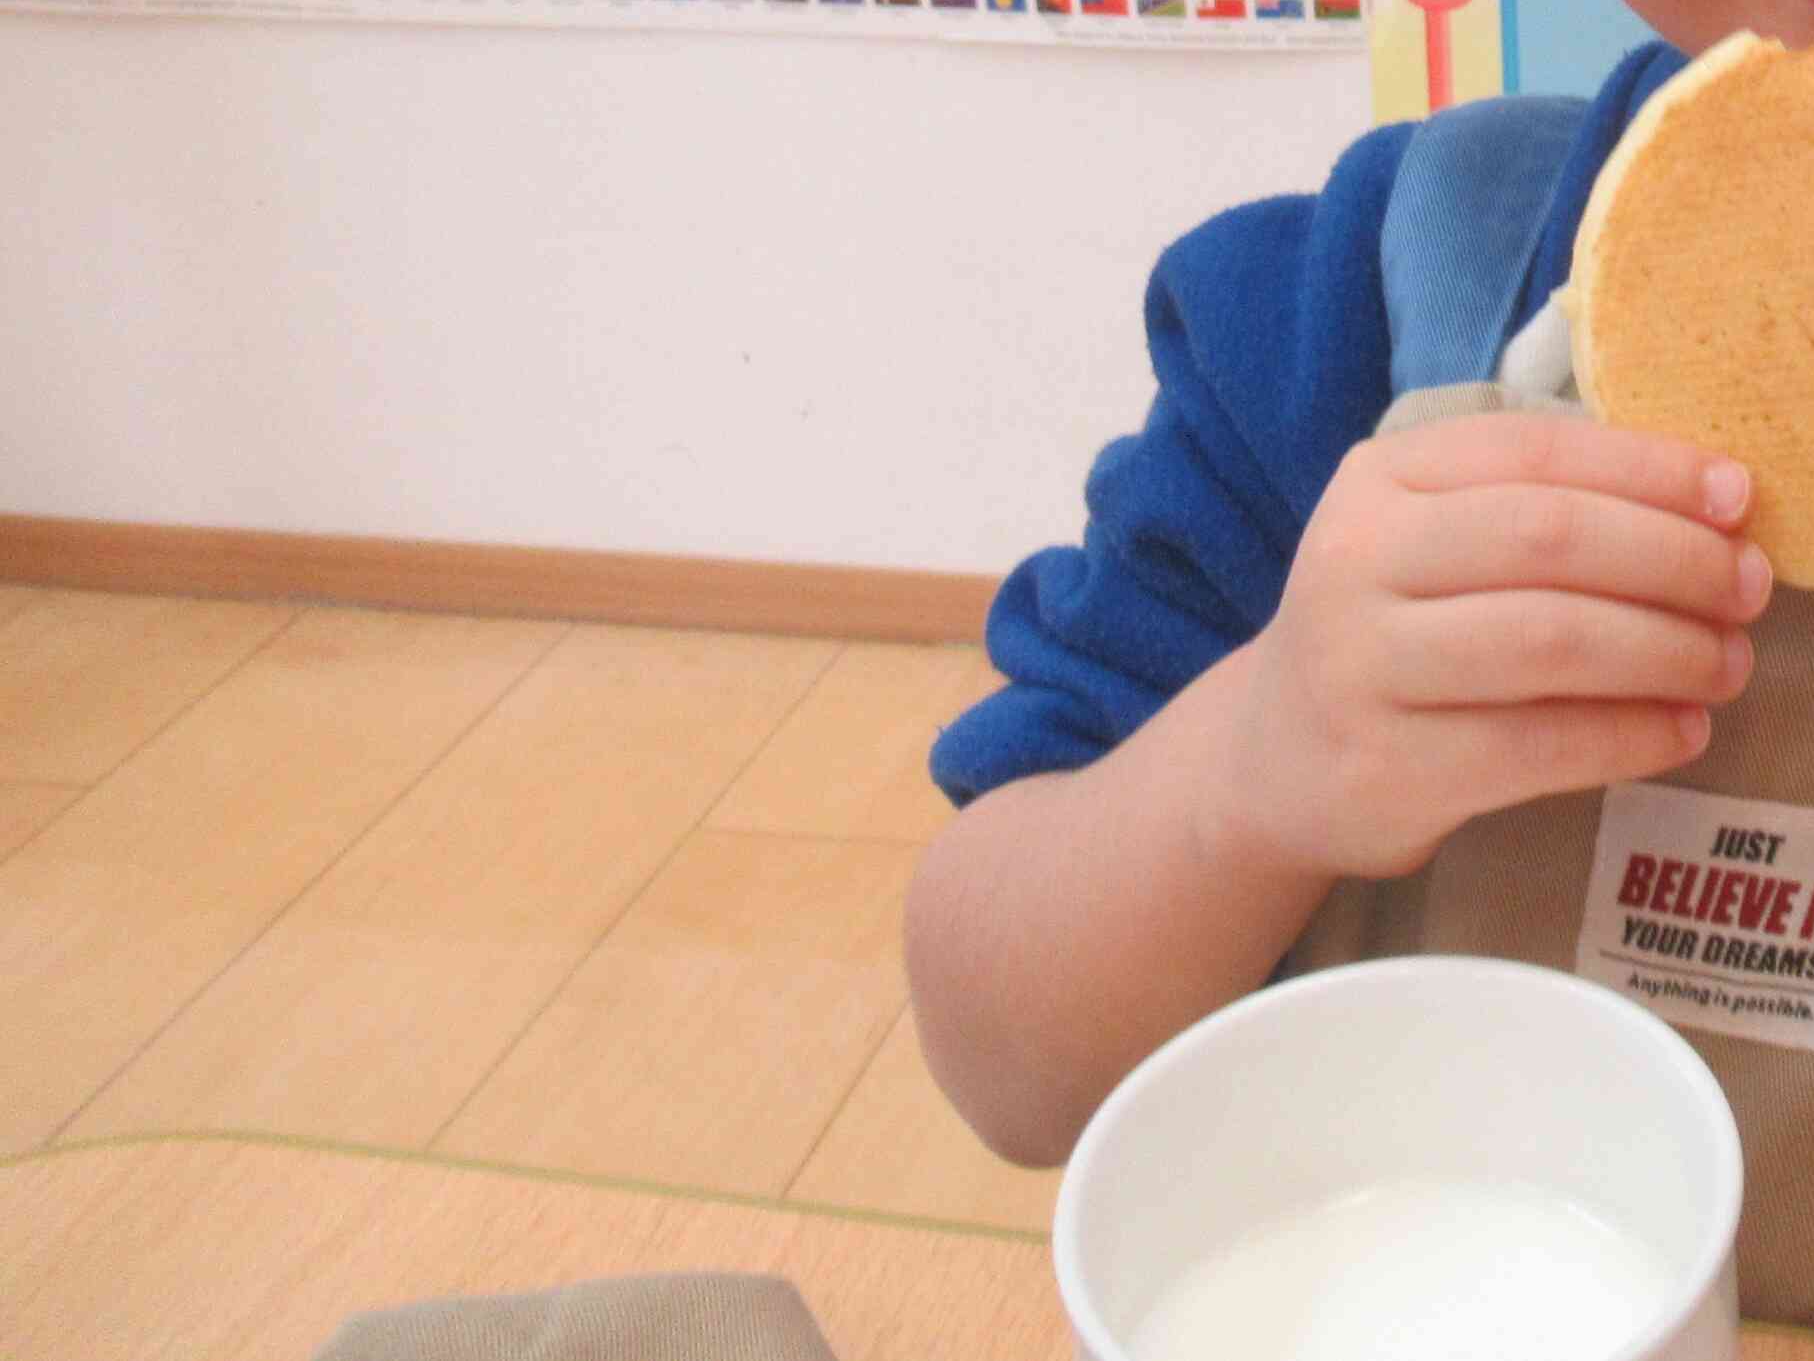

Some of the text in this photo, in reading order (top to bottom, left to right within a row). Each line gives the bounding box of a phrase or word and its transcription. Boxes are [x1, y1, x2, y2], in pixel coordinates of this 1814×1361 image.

[1711, 825, 1785, 864] JUST
[1617, 853, 1802, 935] BELIEVE
[1622, 915, 1699, 960] YOUR
[1628, 971, 1814, 1021] Anything is possible.
